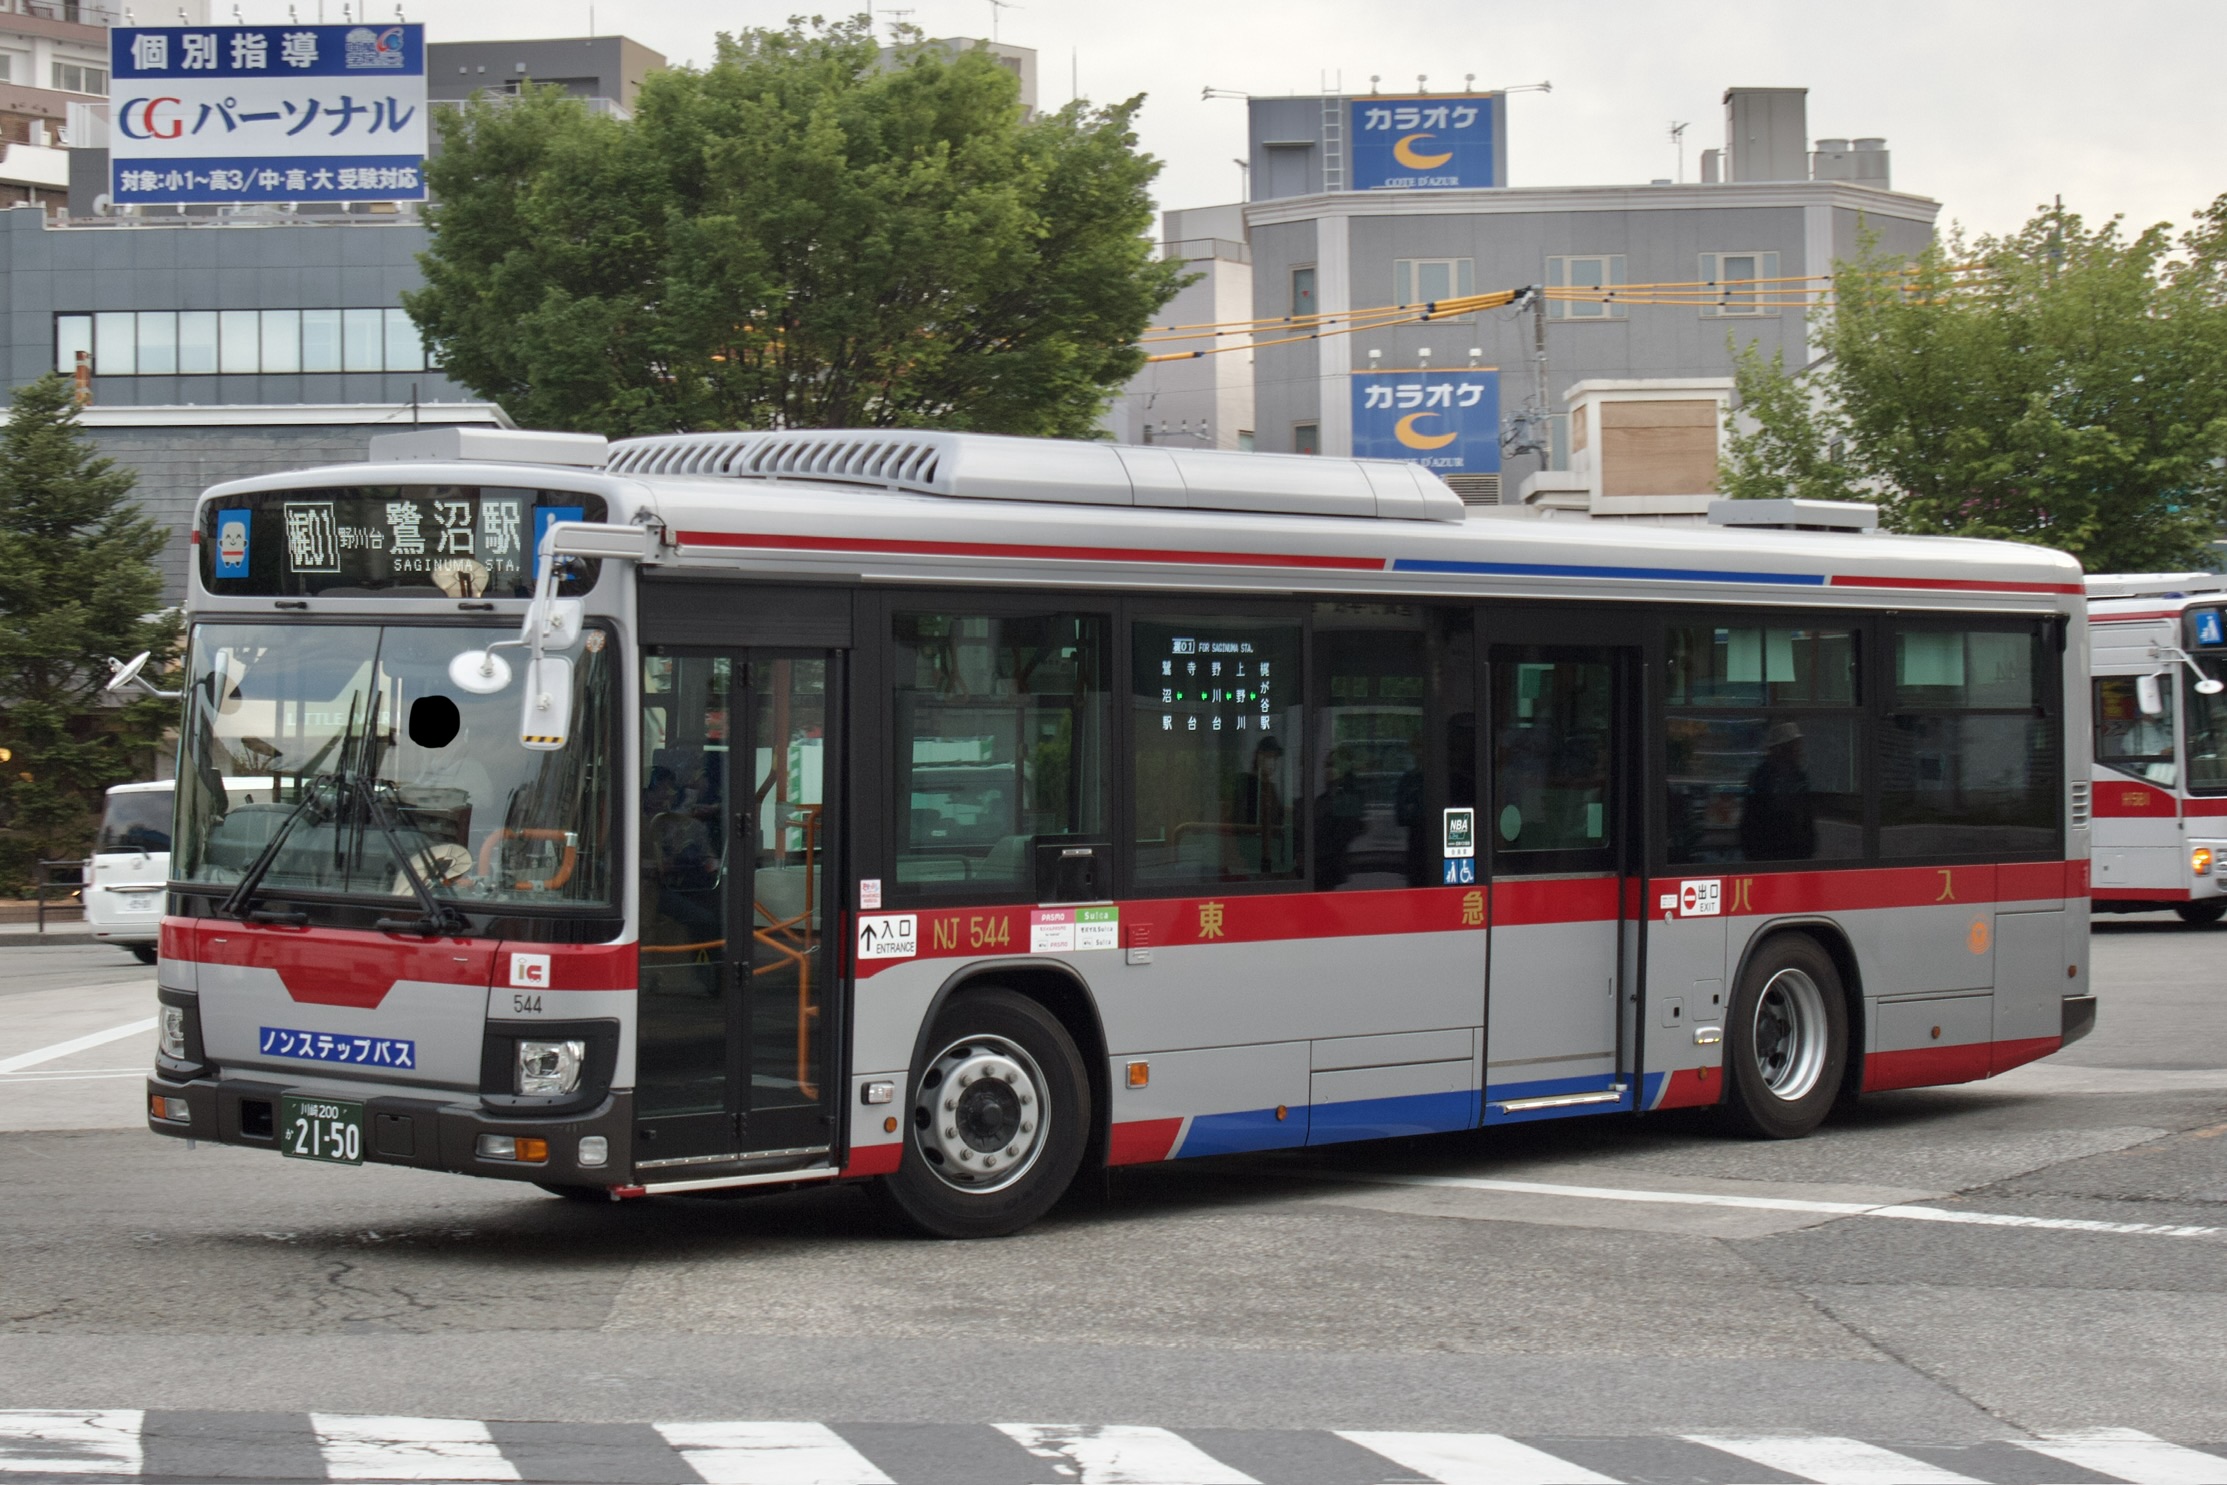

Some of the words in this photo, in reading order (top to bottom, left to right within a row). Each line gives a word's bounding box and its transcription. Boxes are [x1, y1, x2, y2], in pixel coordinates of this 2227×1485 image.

[131, 32, 319, 70] 個別指導
[1364, 106, 1479, 131] カラオケ
[1364, 383, 1485, 409] カラオケ
[337, 527, 385, 550] 野川台
[386, 501, 521, 555] 鷺沼駅
[394, 559, 473, 572] SAGINUMA
[1198, 642, 1210, 652] FOR
[1211, 662, 1221, 730] 野川台
[1236, 662, 1246, 730] 上野川
[1450, 820, 1468, 831] NBA
[1698, 883, 1719, 900] 出口
[1084, 911, 1109, 921] Suica
[1700, 902, 1716, 912] EXIT
[1041, 913, 1065, 922] PASMO
[881, 920, 911, 939] 入口
[932, 917, 960, 950] NJ
[970, 915, 1010, 949] 544
[876, 941, 915, 955] ENTRANCE
[513, 994, 543, 1014] 544
[262, 1030, 413, 1067] ノンステップバス
[295, 1117, 360, 1160] 21-50
